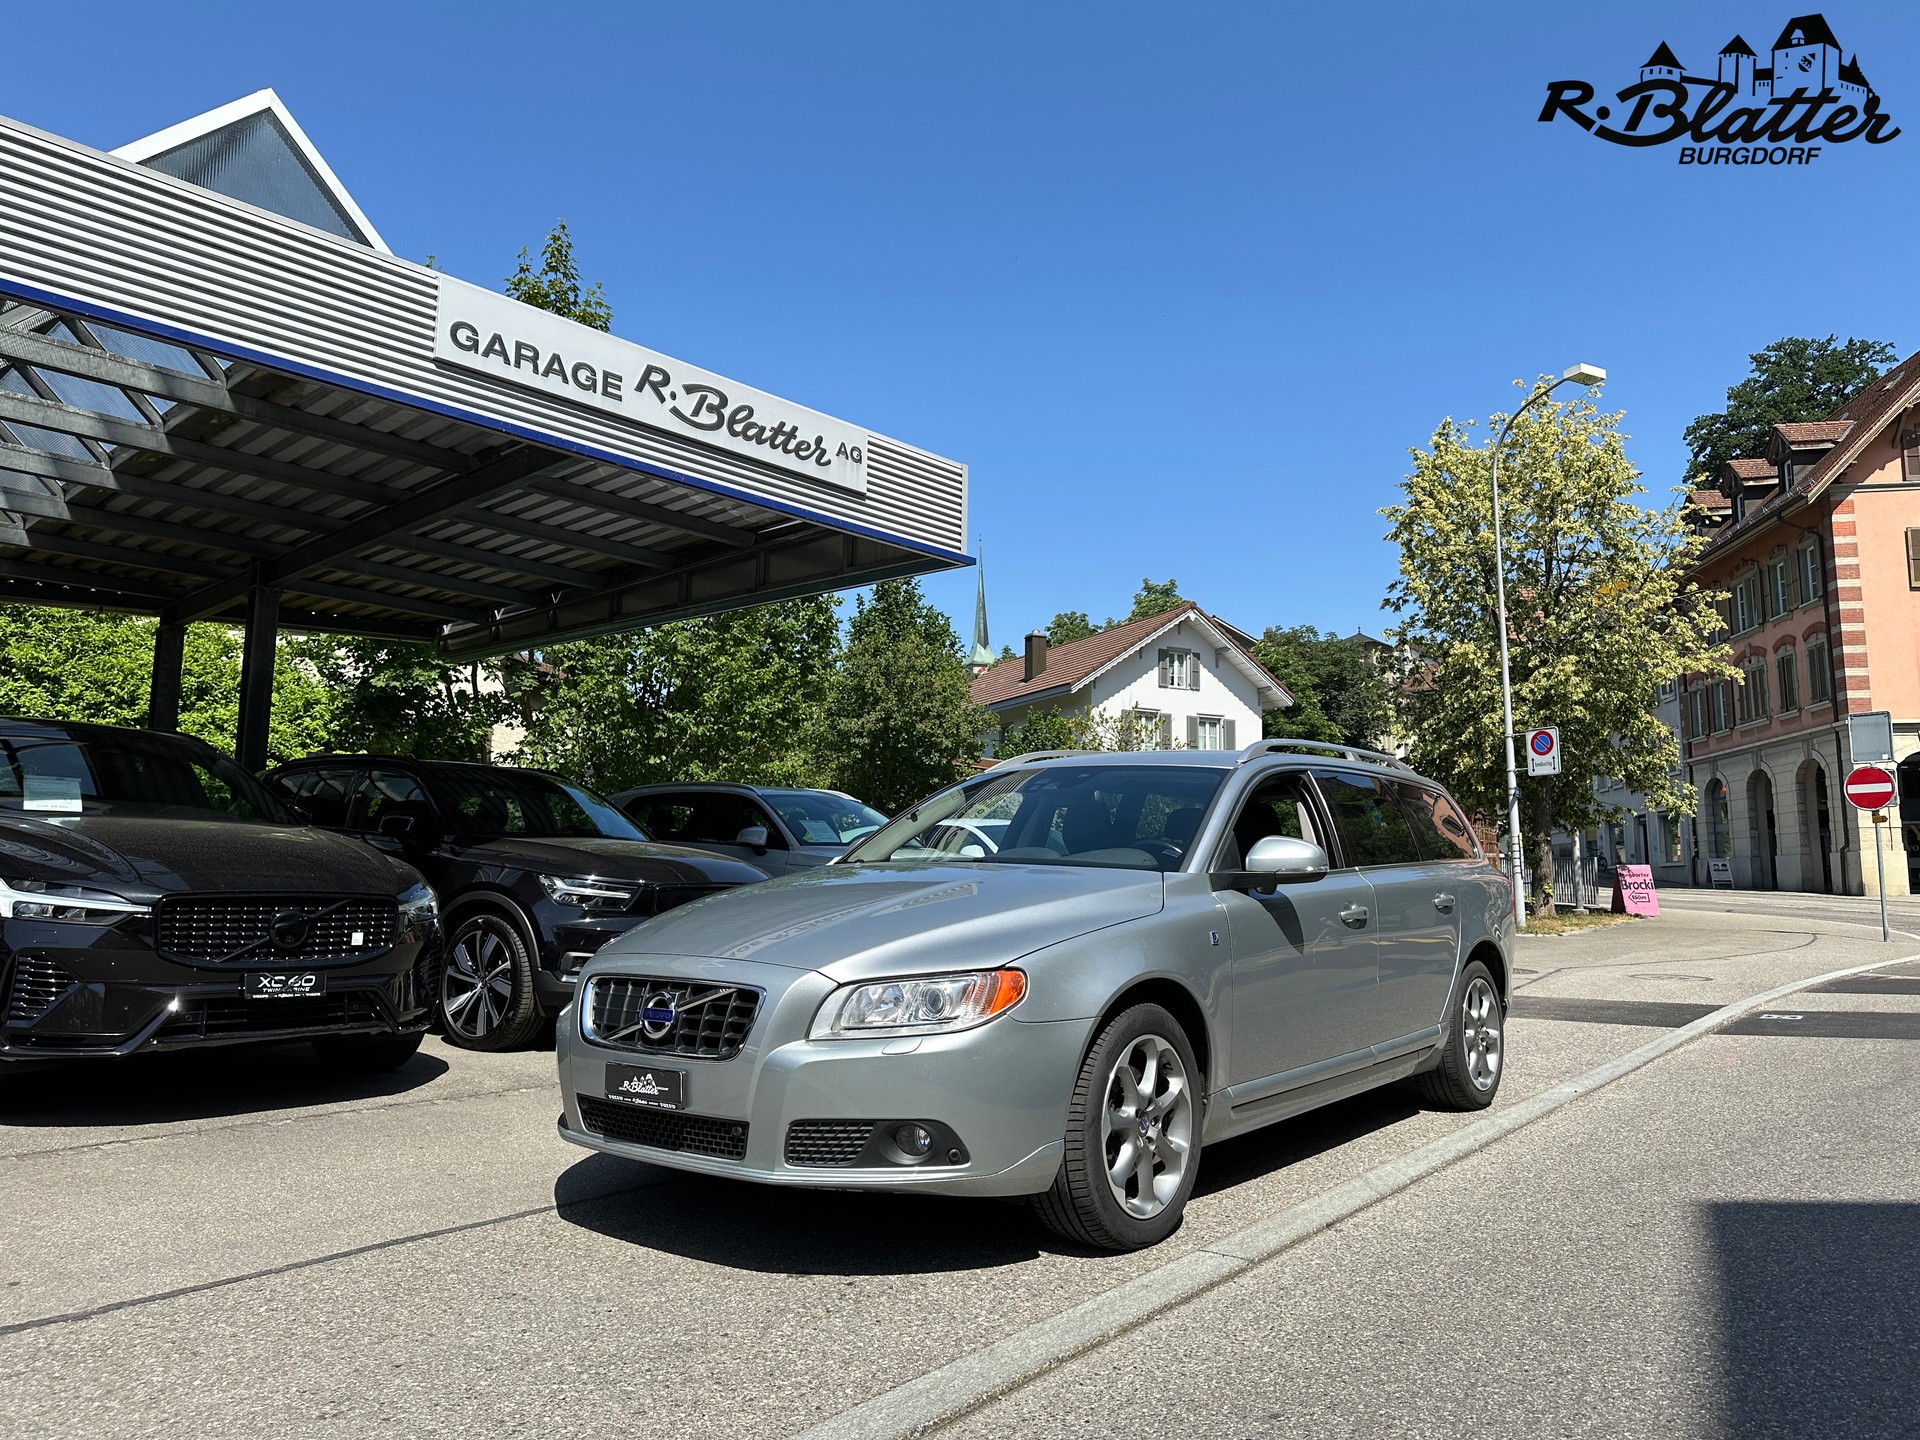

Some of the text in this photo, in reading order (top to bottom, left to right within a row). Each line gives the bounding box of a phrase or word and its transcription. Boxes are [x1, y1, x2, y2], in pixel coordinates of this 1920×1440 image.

[449, 320, 623, 402] GARAGE
[836, 441, 863, 464] AG
[1621, 879, 1654, 890] Brocki
